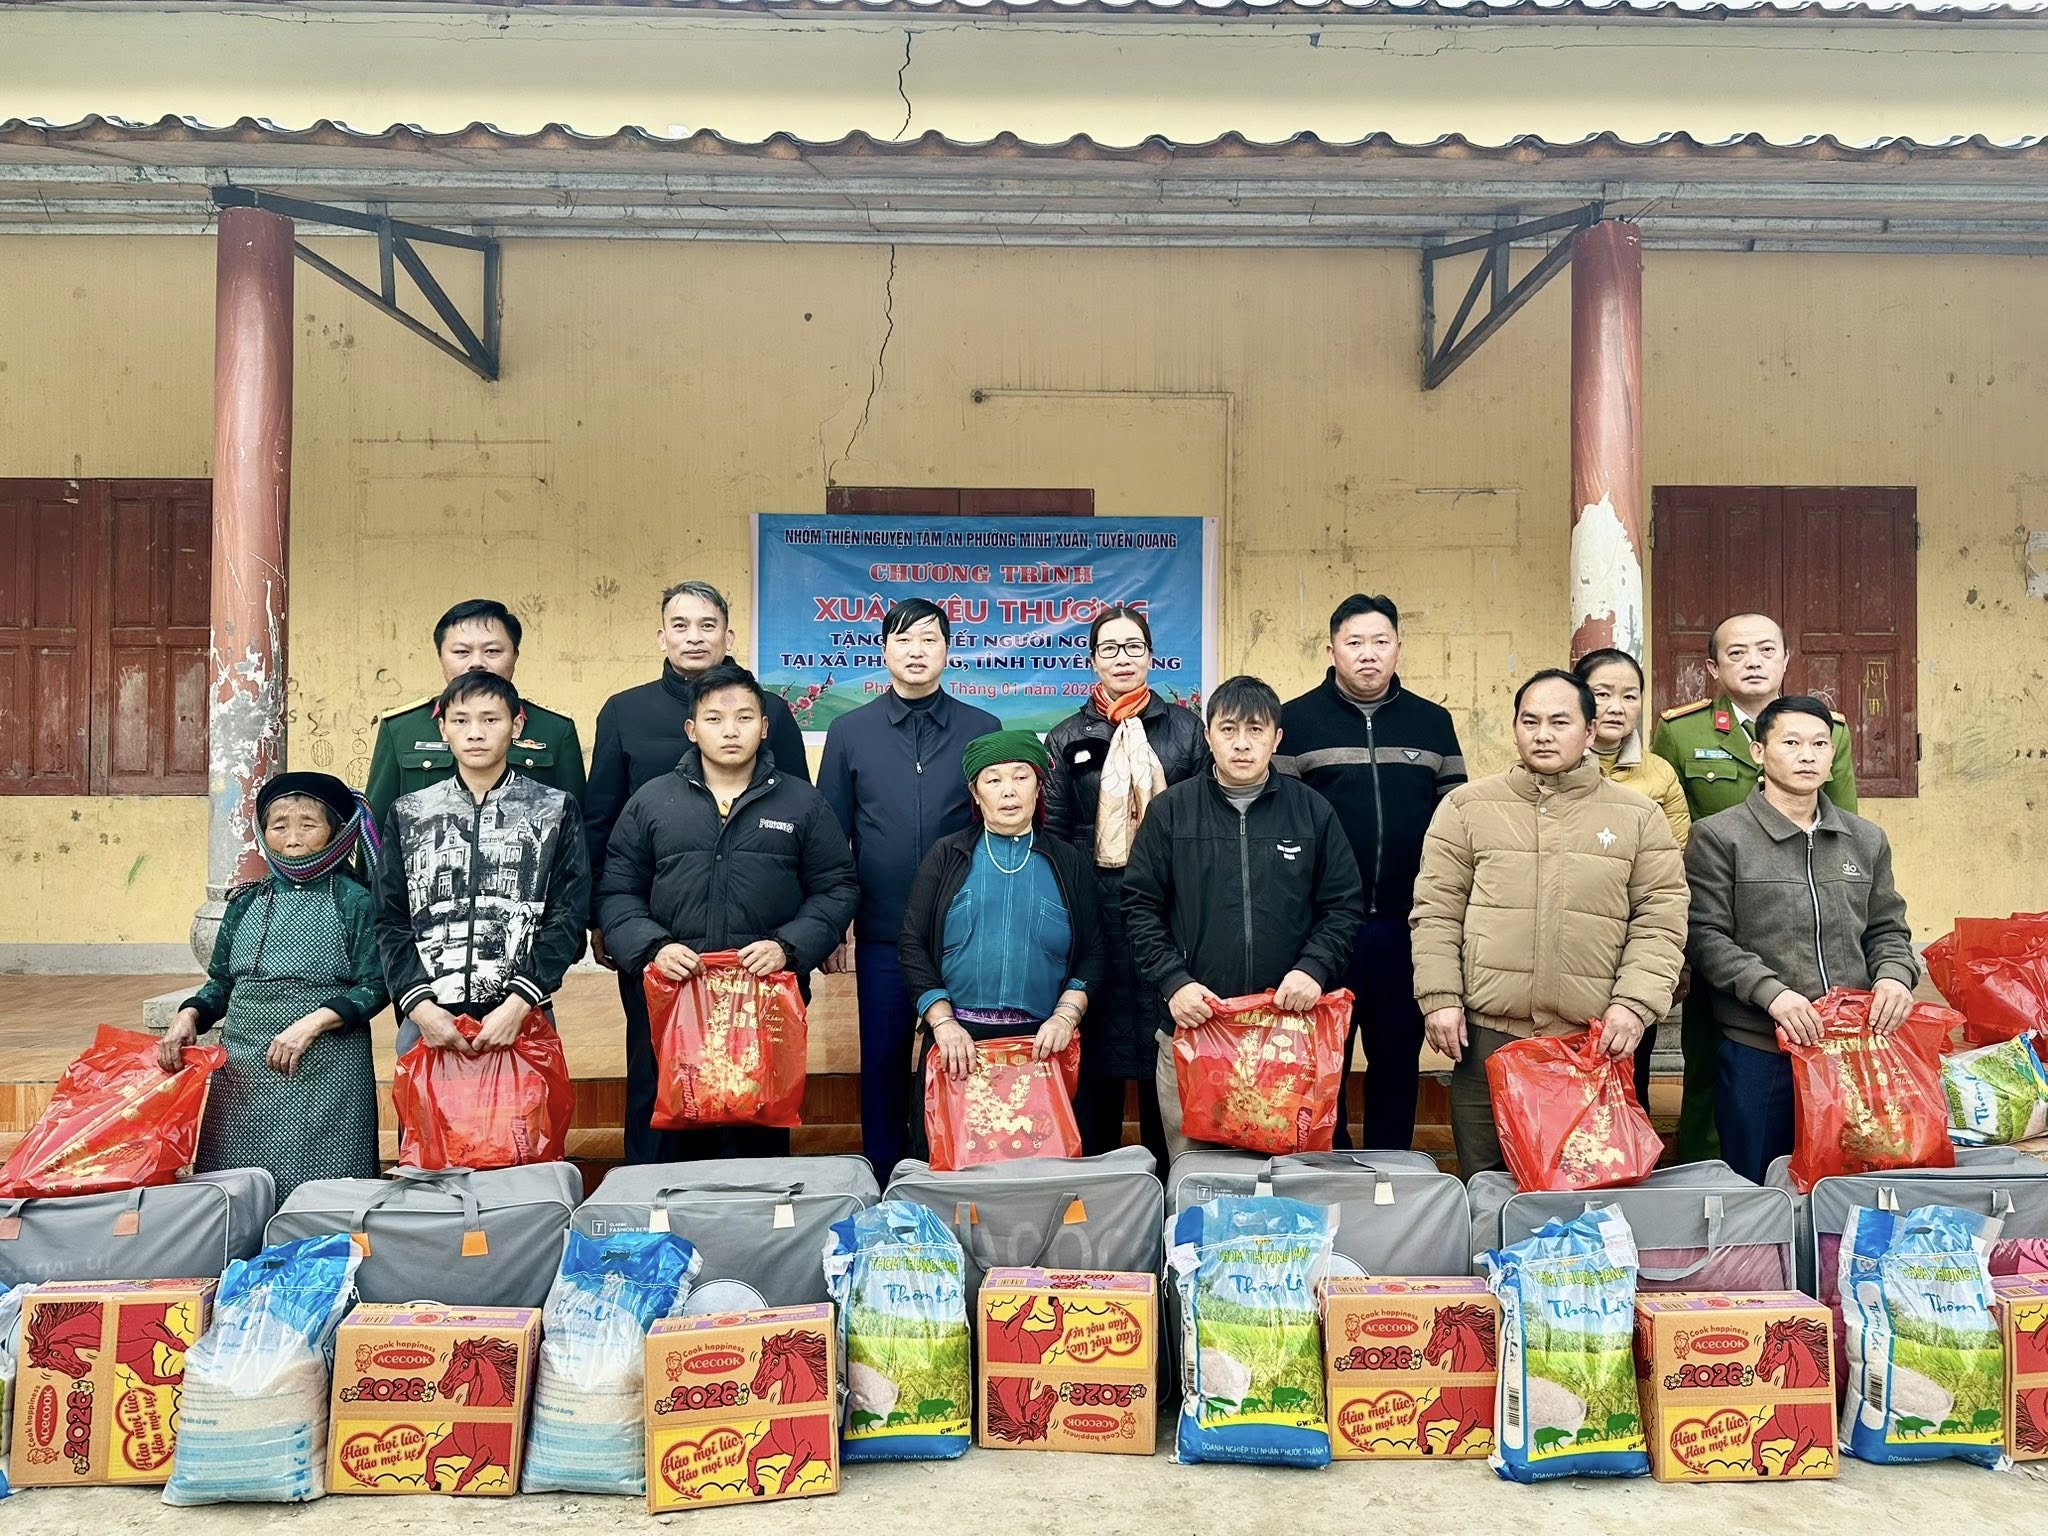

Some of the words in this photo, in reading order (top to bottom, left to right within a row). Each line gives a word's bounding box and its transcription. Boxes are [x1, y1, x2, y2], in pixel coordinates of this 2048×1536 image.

[785, 527, 821, 545] NHÓM
[826, 528, 860, 548] THIỆN
[864, 529, 913, 549] NGUYỆN
[916, 529, 942, 547] TÂM
[944, 532, 963, 547] AN
[966, 530, 1016, 548] PHƯỜNG
[1020, 531, 1051, 548] MINH
[1055, 530, 1092, 550] XUÂN,
[1095, 530, 1133, 549] TUYÊN
[1136, 533, 1177, 551] QUANG
[869, 562, 991, 583] CHƯƠNG
[1000, 562, 1093, 584] TRÌNH
[814, 592, 898, 622] XUÂ
[983, 632, 1052, 648] NGƯỜI
[780, 653, 815, 670] TẠI
[819, 652, 850, 668] XÃ
[853, 654, 888, 668] PH
[974, 652, 1024, 669] TỈNH
[949, 682, 997, 699] Tháng
[1002, 683, 1017, 696] 01
[1024, 683, 1057, 696] năm
[1062, 683, 1096, 696] 2026
[1350, 1346, 1413, 1370] 2026
[1680, 1362, 1744, 1388] 2026
[357, 1377, 427, 1401] 2026
[670, 1381, 739, 1411] 2026
[1070, 1382, 1132, 1407] 2026
[64, 1390, 93, 1458] 2026
